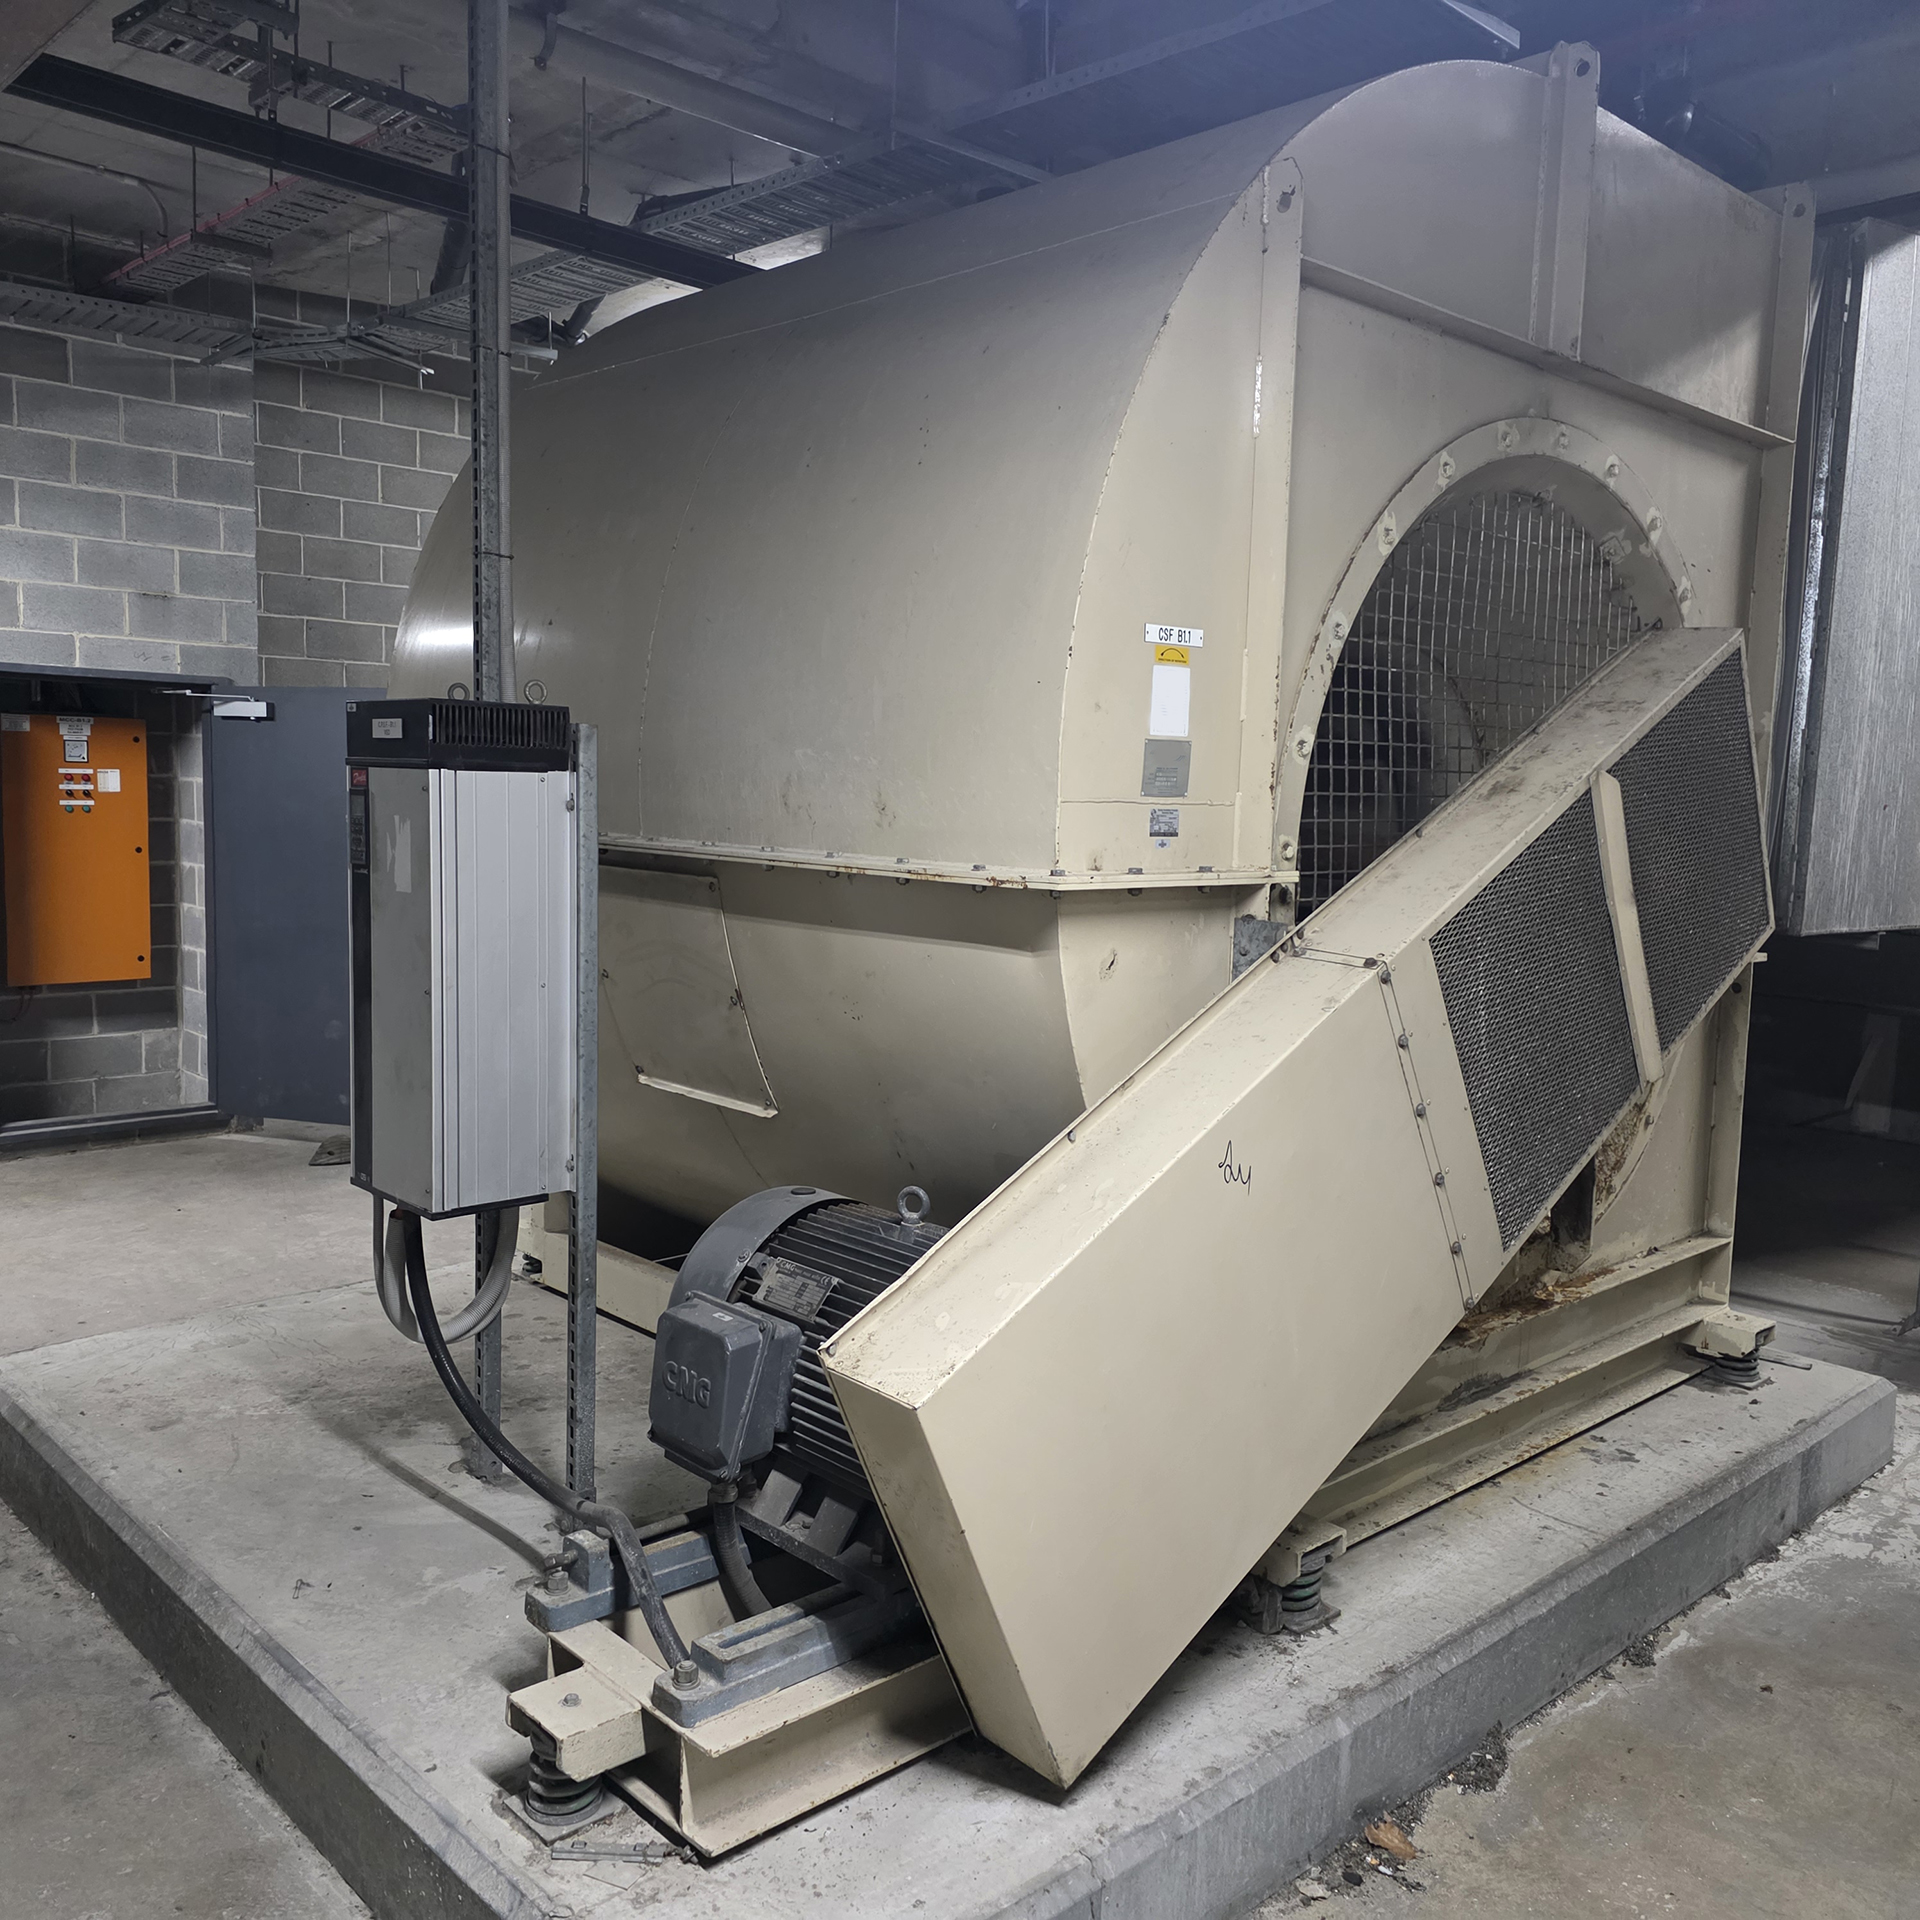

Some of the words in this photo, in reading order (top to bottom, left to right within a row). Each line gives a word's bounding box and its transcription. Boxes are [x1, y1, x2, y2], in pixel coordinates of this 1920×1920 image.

[1158, 627, 1174, 642] CSF
[1177, 629, 1192, 644] B1.1
[780, 1260, 796, 1272] CMG
[662, 1360, 711, 1409] CMG
